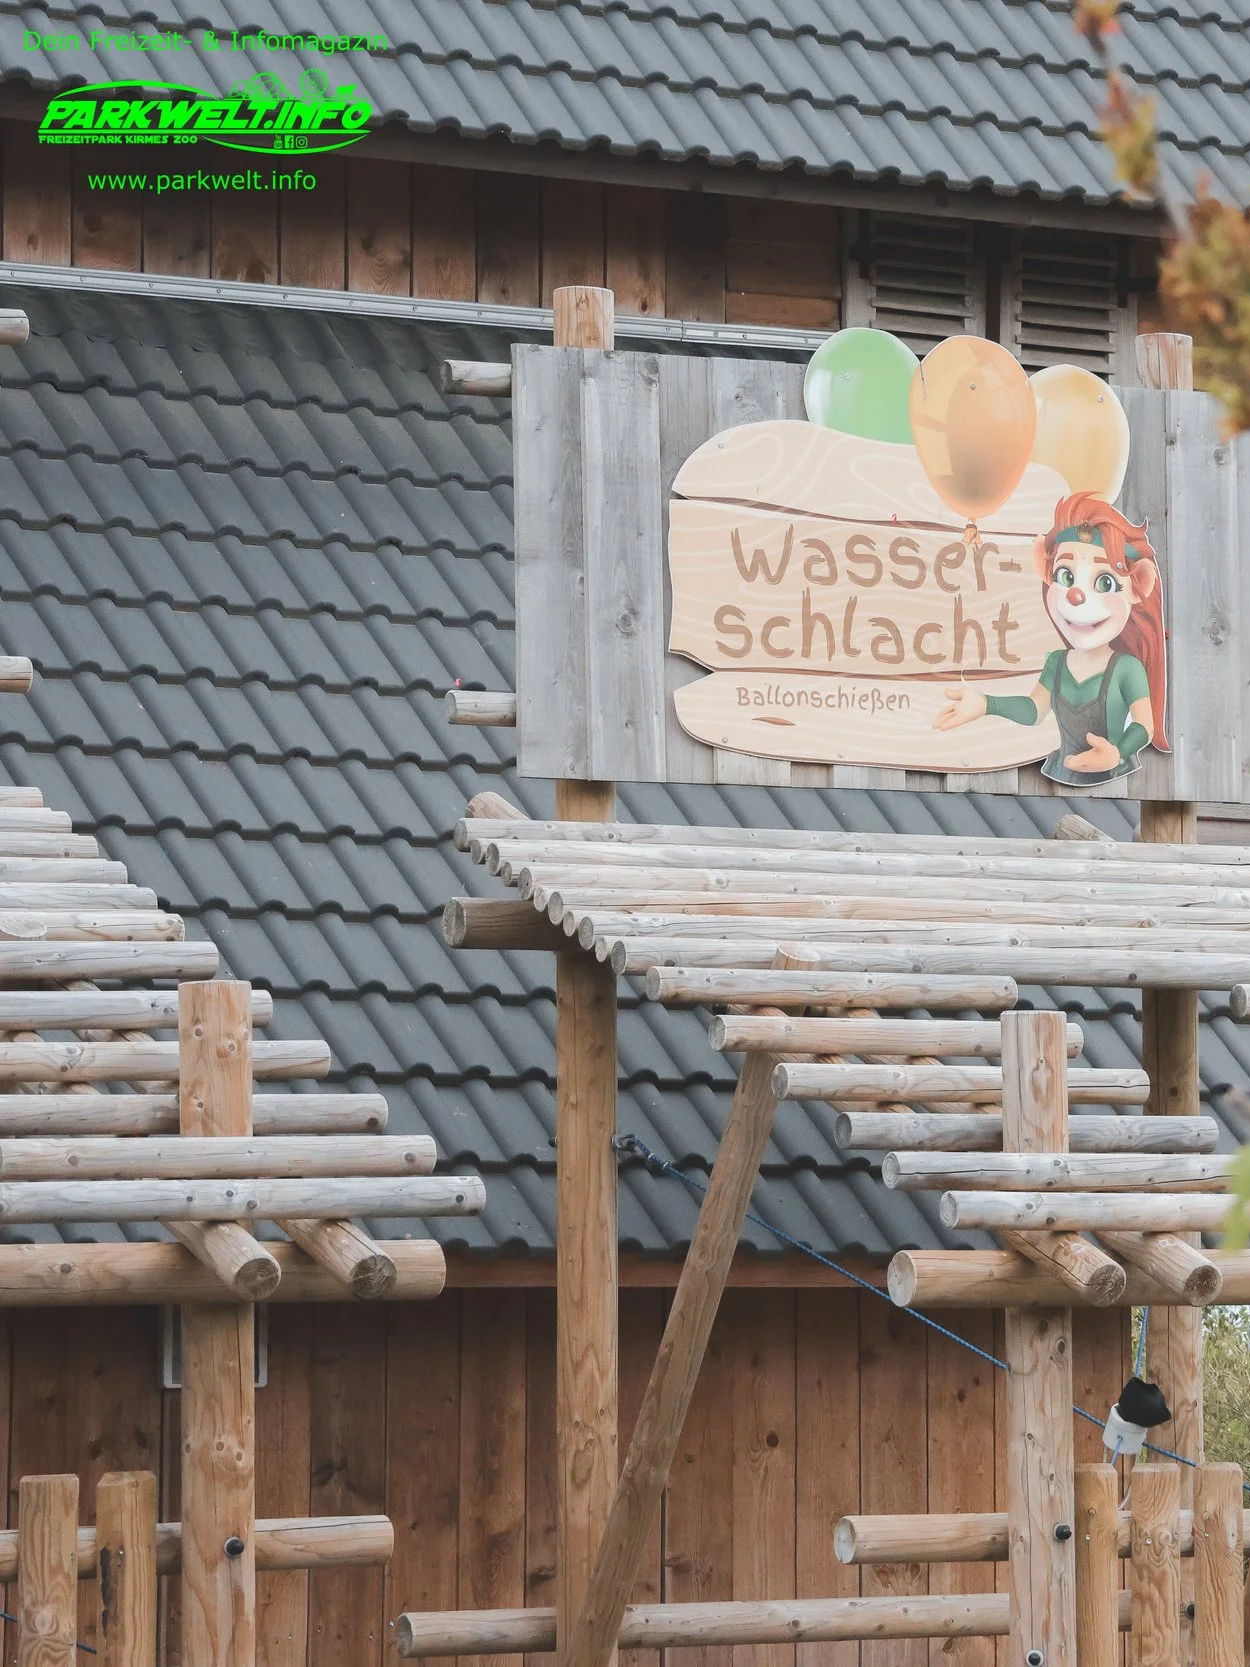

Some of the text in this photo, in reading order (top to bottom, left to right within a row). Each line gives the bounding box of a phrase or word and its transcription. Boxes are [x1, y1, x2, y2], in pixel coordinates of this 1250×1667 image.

[731, 522, 1022, 593] Wasser-
[713, 586, 1021, 667] schlacht
[736, 685, 910, 714] Ballonschießen
